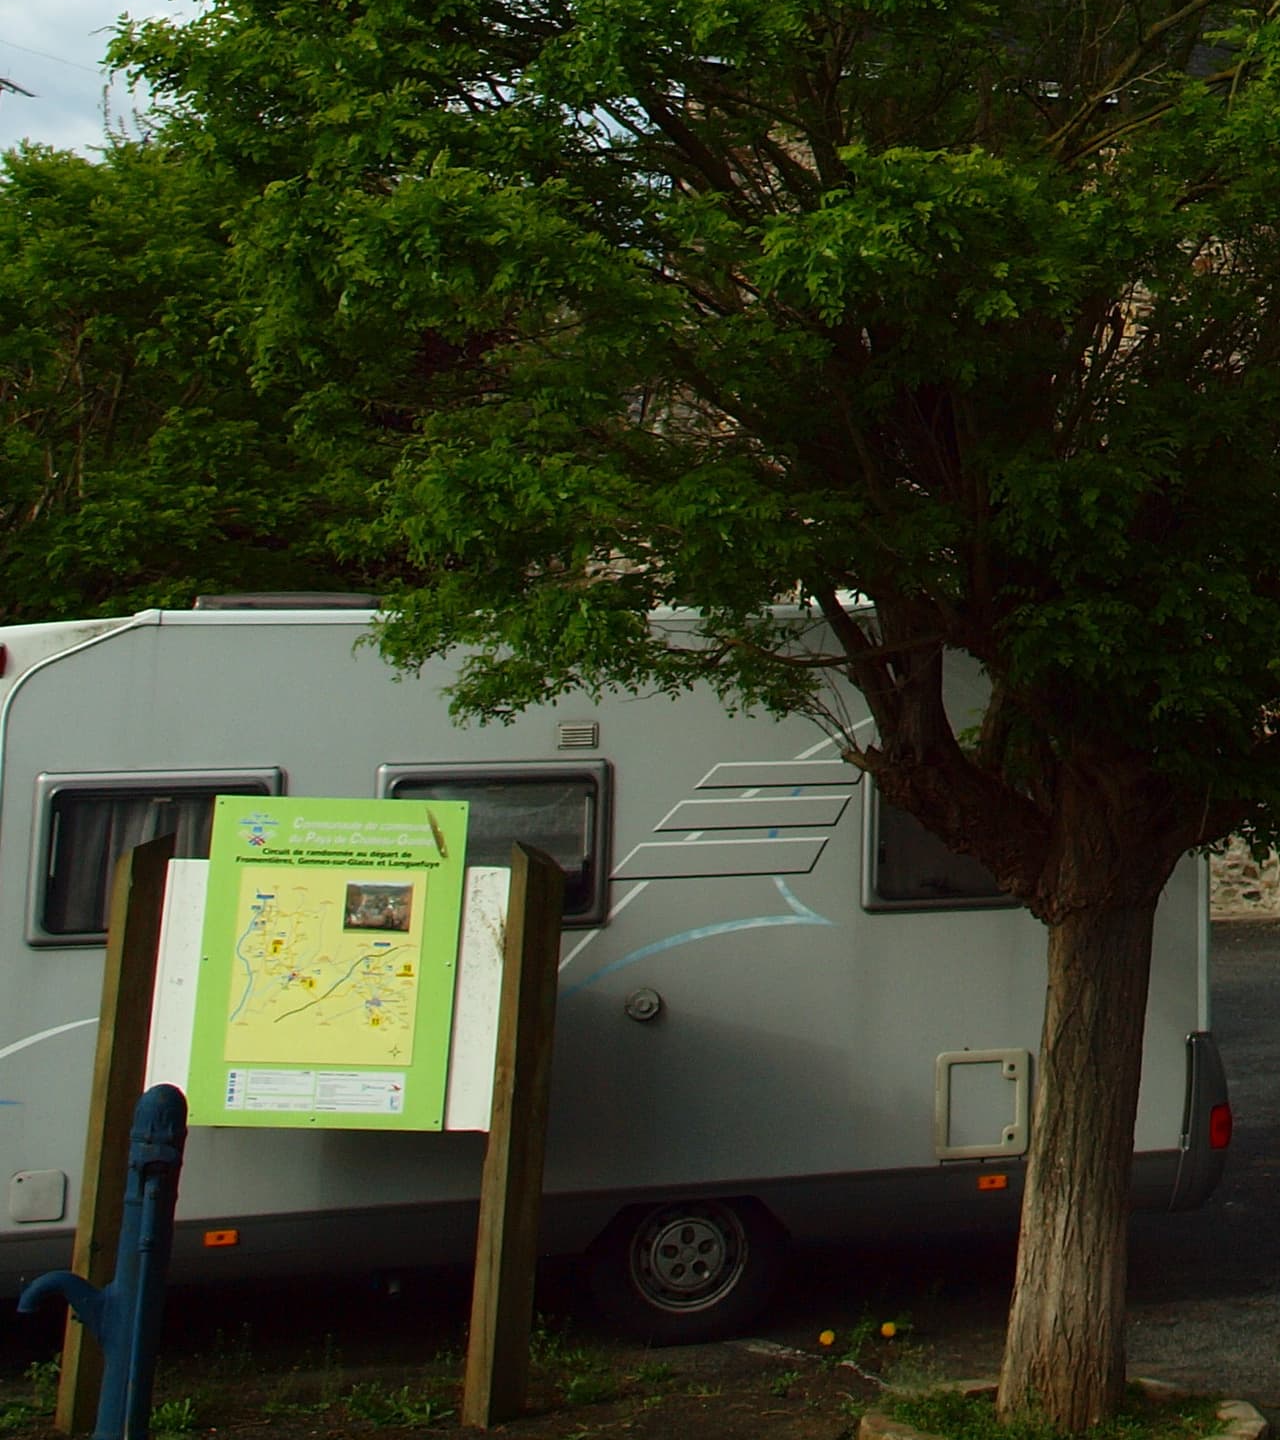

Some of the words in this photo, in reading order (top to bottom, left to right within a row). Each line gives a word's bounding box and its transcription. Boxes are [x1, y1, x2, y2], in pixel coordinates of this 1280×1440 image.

[364, 821, 377, 830] de
[289, 834, 302, 843] du
[305, 831, 331, 845] Pays
[334, 834, 346, 843] de
[262, 847, 290, 855] Circuit
[306, 848, 354, 857] randonnée
[370, 850, 398, 859] départ
[298, 857, 374, 866] Gennes-sur-Glaize
[388, 859, 440, 869] Longuefuye
